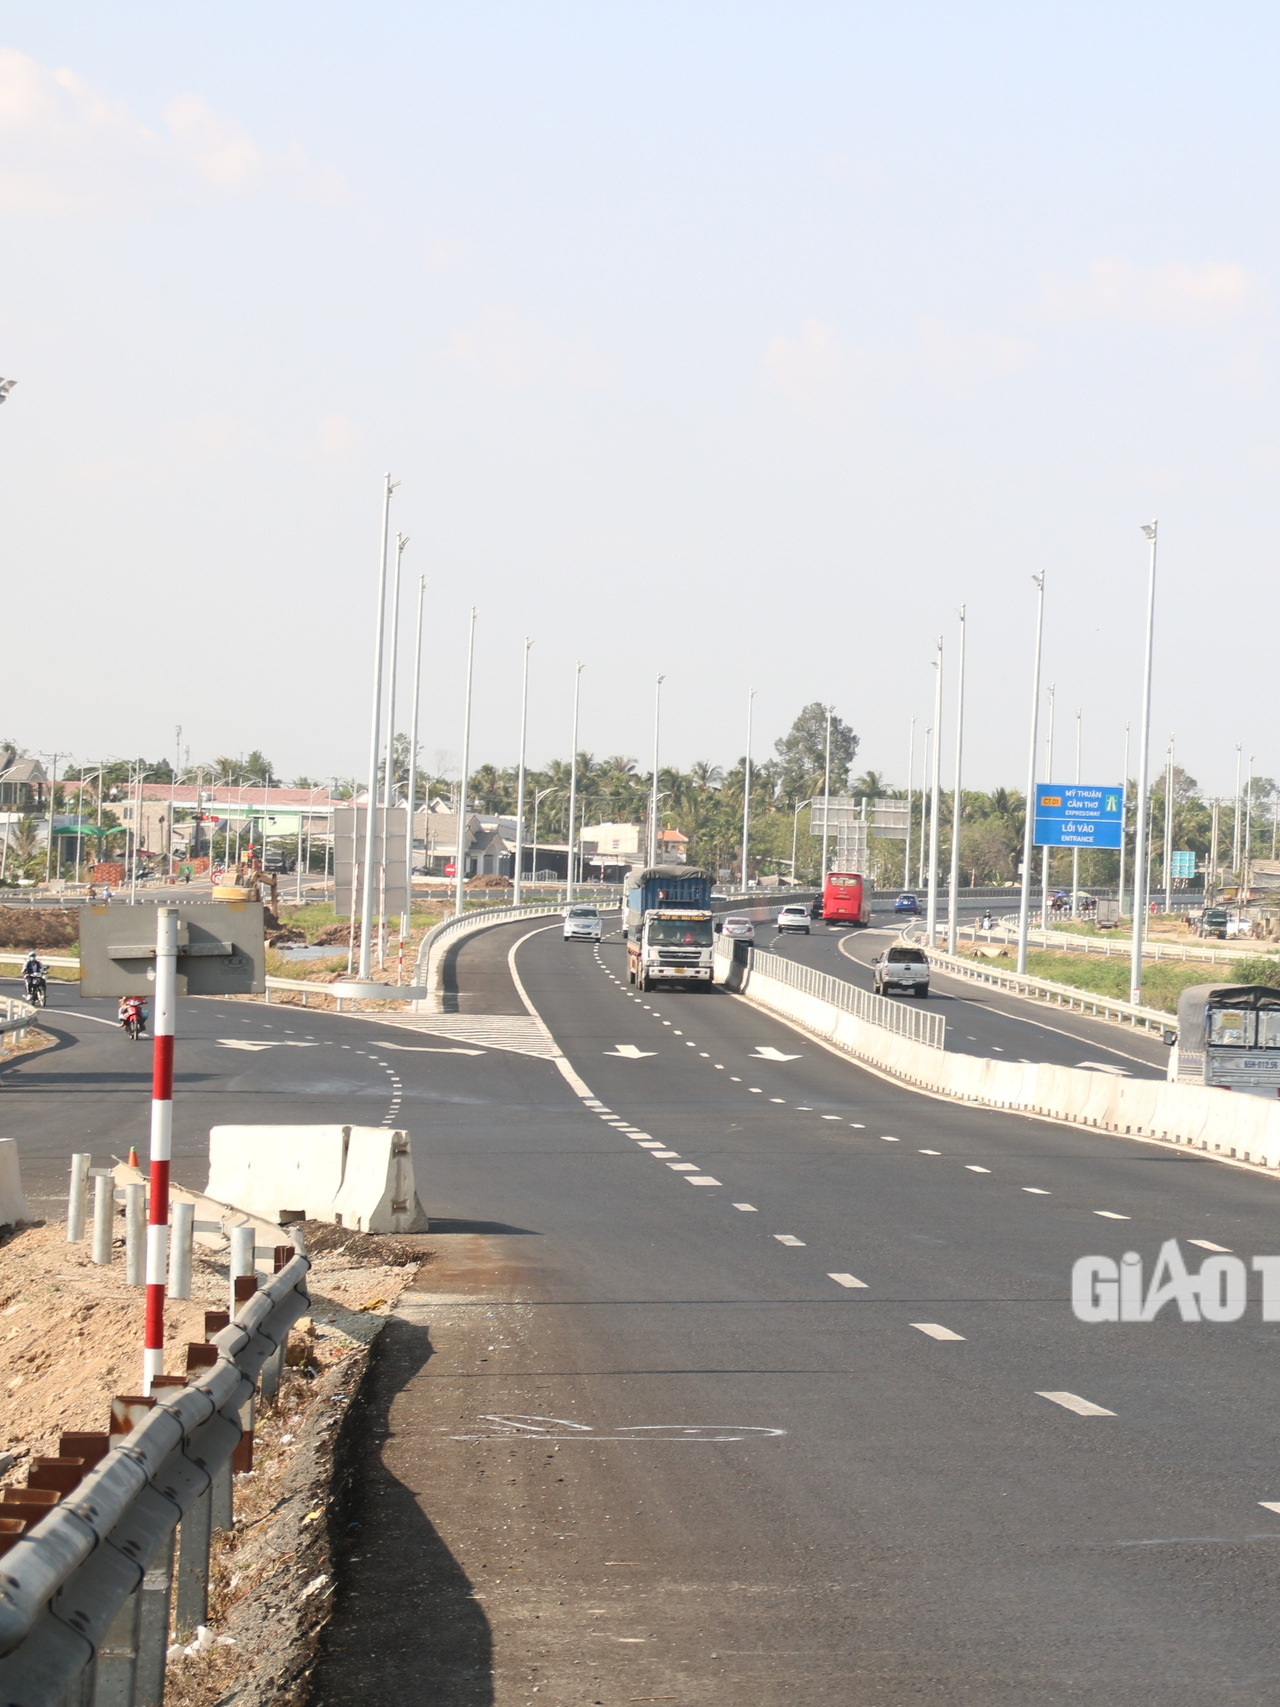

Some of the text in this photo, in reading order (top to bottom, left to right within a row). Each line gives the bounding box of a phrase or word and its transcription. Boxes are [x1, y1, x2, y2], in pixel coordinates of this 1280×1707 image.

[1077, 790, 1102, 799] THUẬN
[1067, 799, 1083, 808] CẦN
[1062, 821, 1095, 833] LỐI VÀO
[1061, 835, 1094, 843] ENTRANCE
